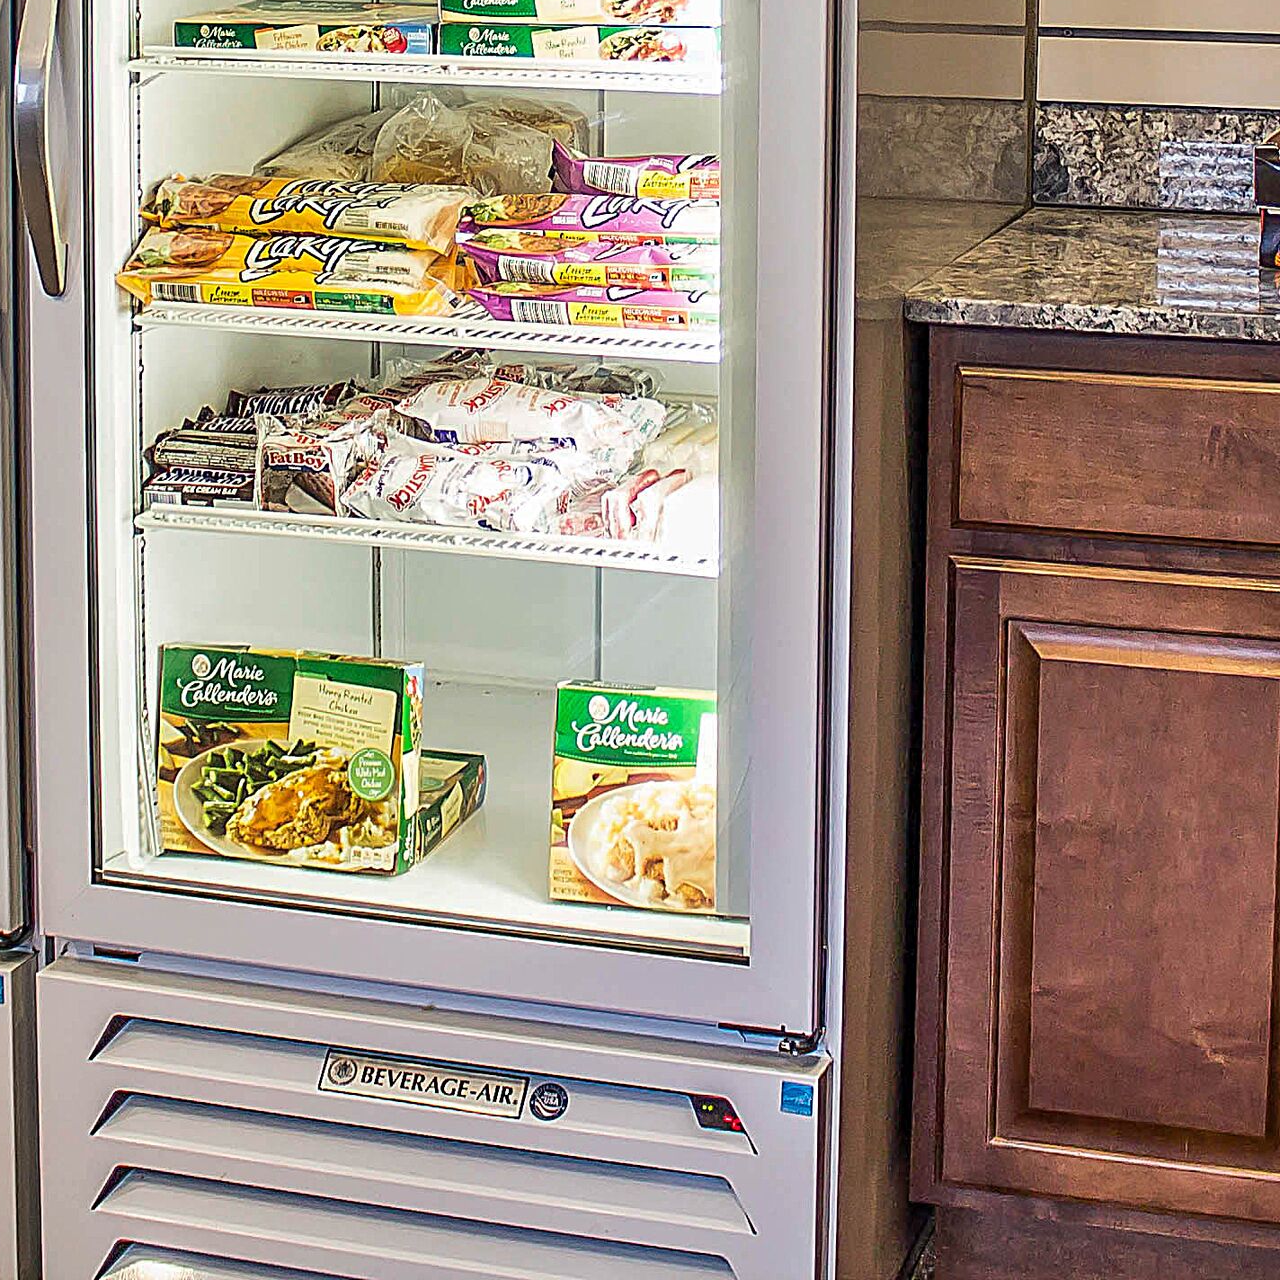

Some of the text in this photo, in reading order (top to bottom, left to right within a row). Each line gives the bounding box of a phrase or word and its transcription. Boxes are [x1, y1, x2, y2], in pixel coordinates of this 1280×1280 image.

[208, 27, 236, 39] Marie
[478, 28, 510, 43] Marie
[460, 41, 517, 57] Callender's
[246, 390, 324, 417] SNICKERS
[269, 451, 326, 470] FatBoy
[183, 486, 238, 496] ICE CREAM BAR
[209, 657, 265, 688] Marie
[177, 677, 278, 708] Callender's
[605, 699, 669, 732] Marie
[571, 720, 683, 752] Callender's
